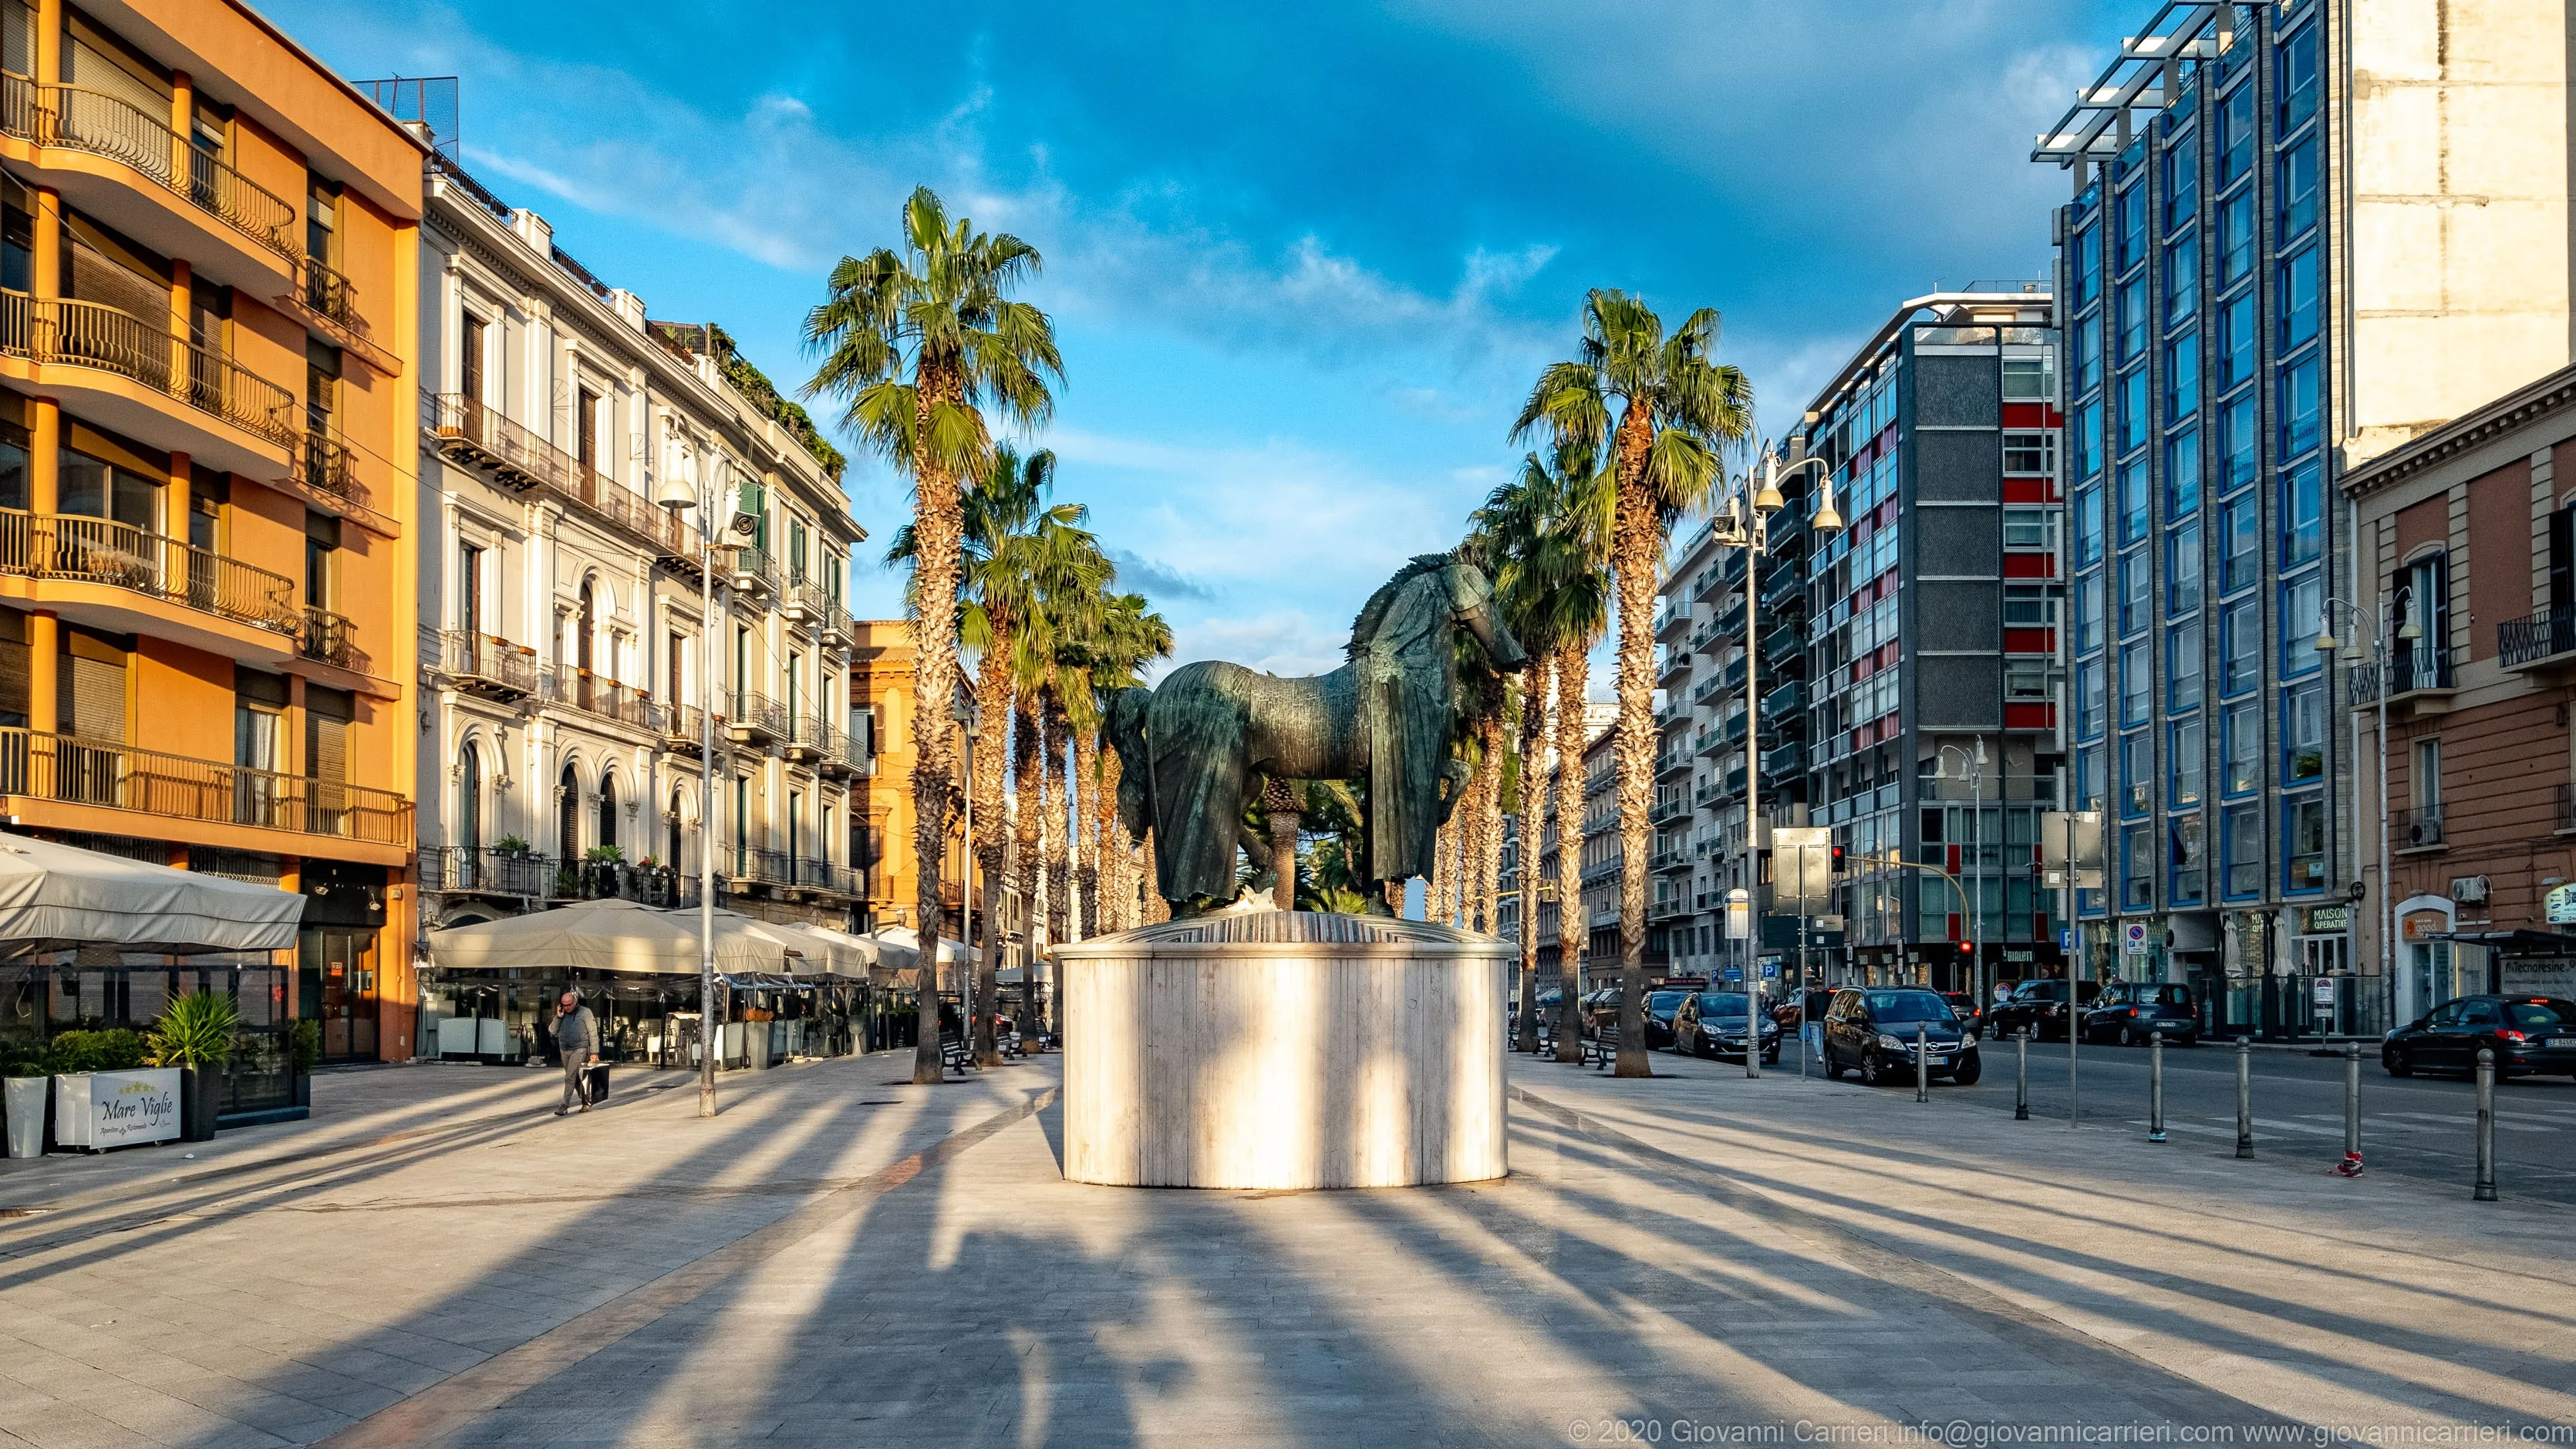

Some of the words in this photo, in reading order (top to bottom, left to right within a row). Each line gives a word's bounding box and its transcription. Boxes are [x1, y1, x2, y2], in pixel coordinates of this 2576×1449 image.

[2291, 426, 2315, 445] Deloitte
[1765, 965, 1773, 976] P
[2514, 961, 2565, 973] Tecnoresine
[102, 1100, 136, 1120] Mare
[140, 1092, 173, 1126] Viglie
